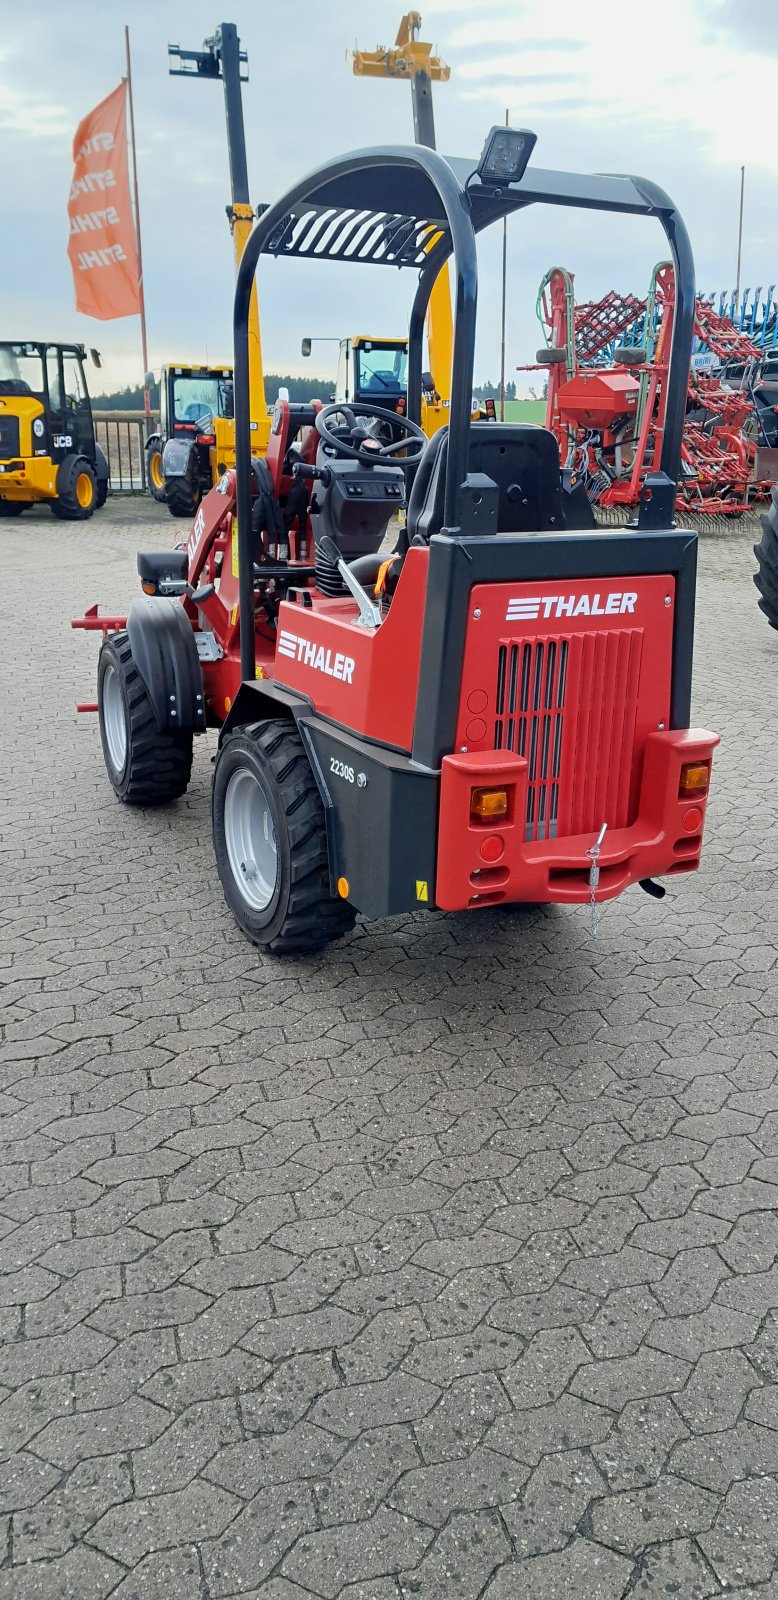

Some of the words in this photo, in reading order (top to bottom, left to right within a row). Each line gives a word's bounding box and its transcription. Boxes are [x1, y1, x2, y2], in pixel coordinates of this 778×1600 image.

[53, 436, 72, 448] JCB
[188, 508, 205, 570] ALER
[541, 592, 638, 619] THALER
[296, 637, 355, 684] THALER
[330, 757, 355, 784] 2230S
